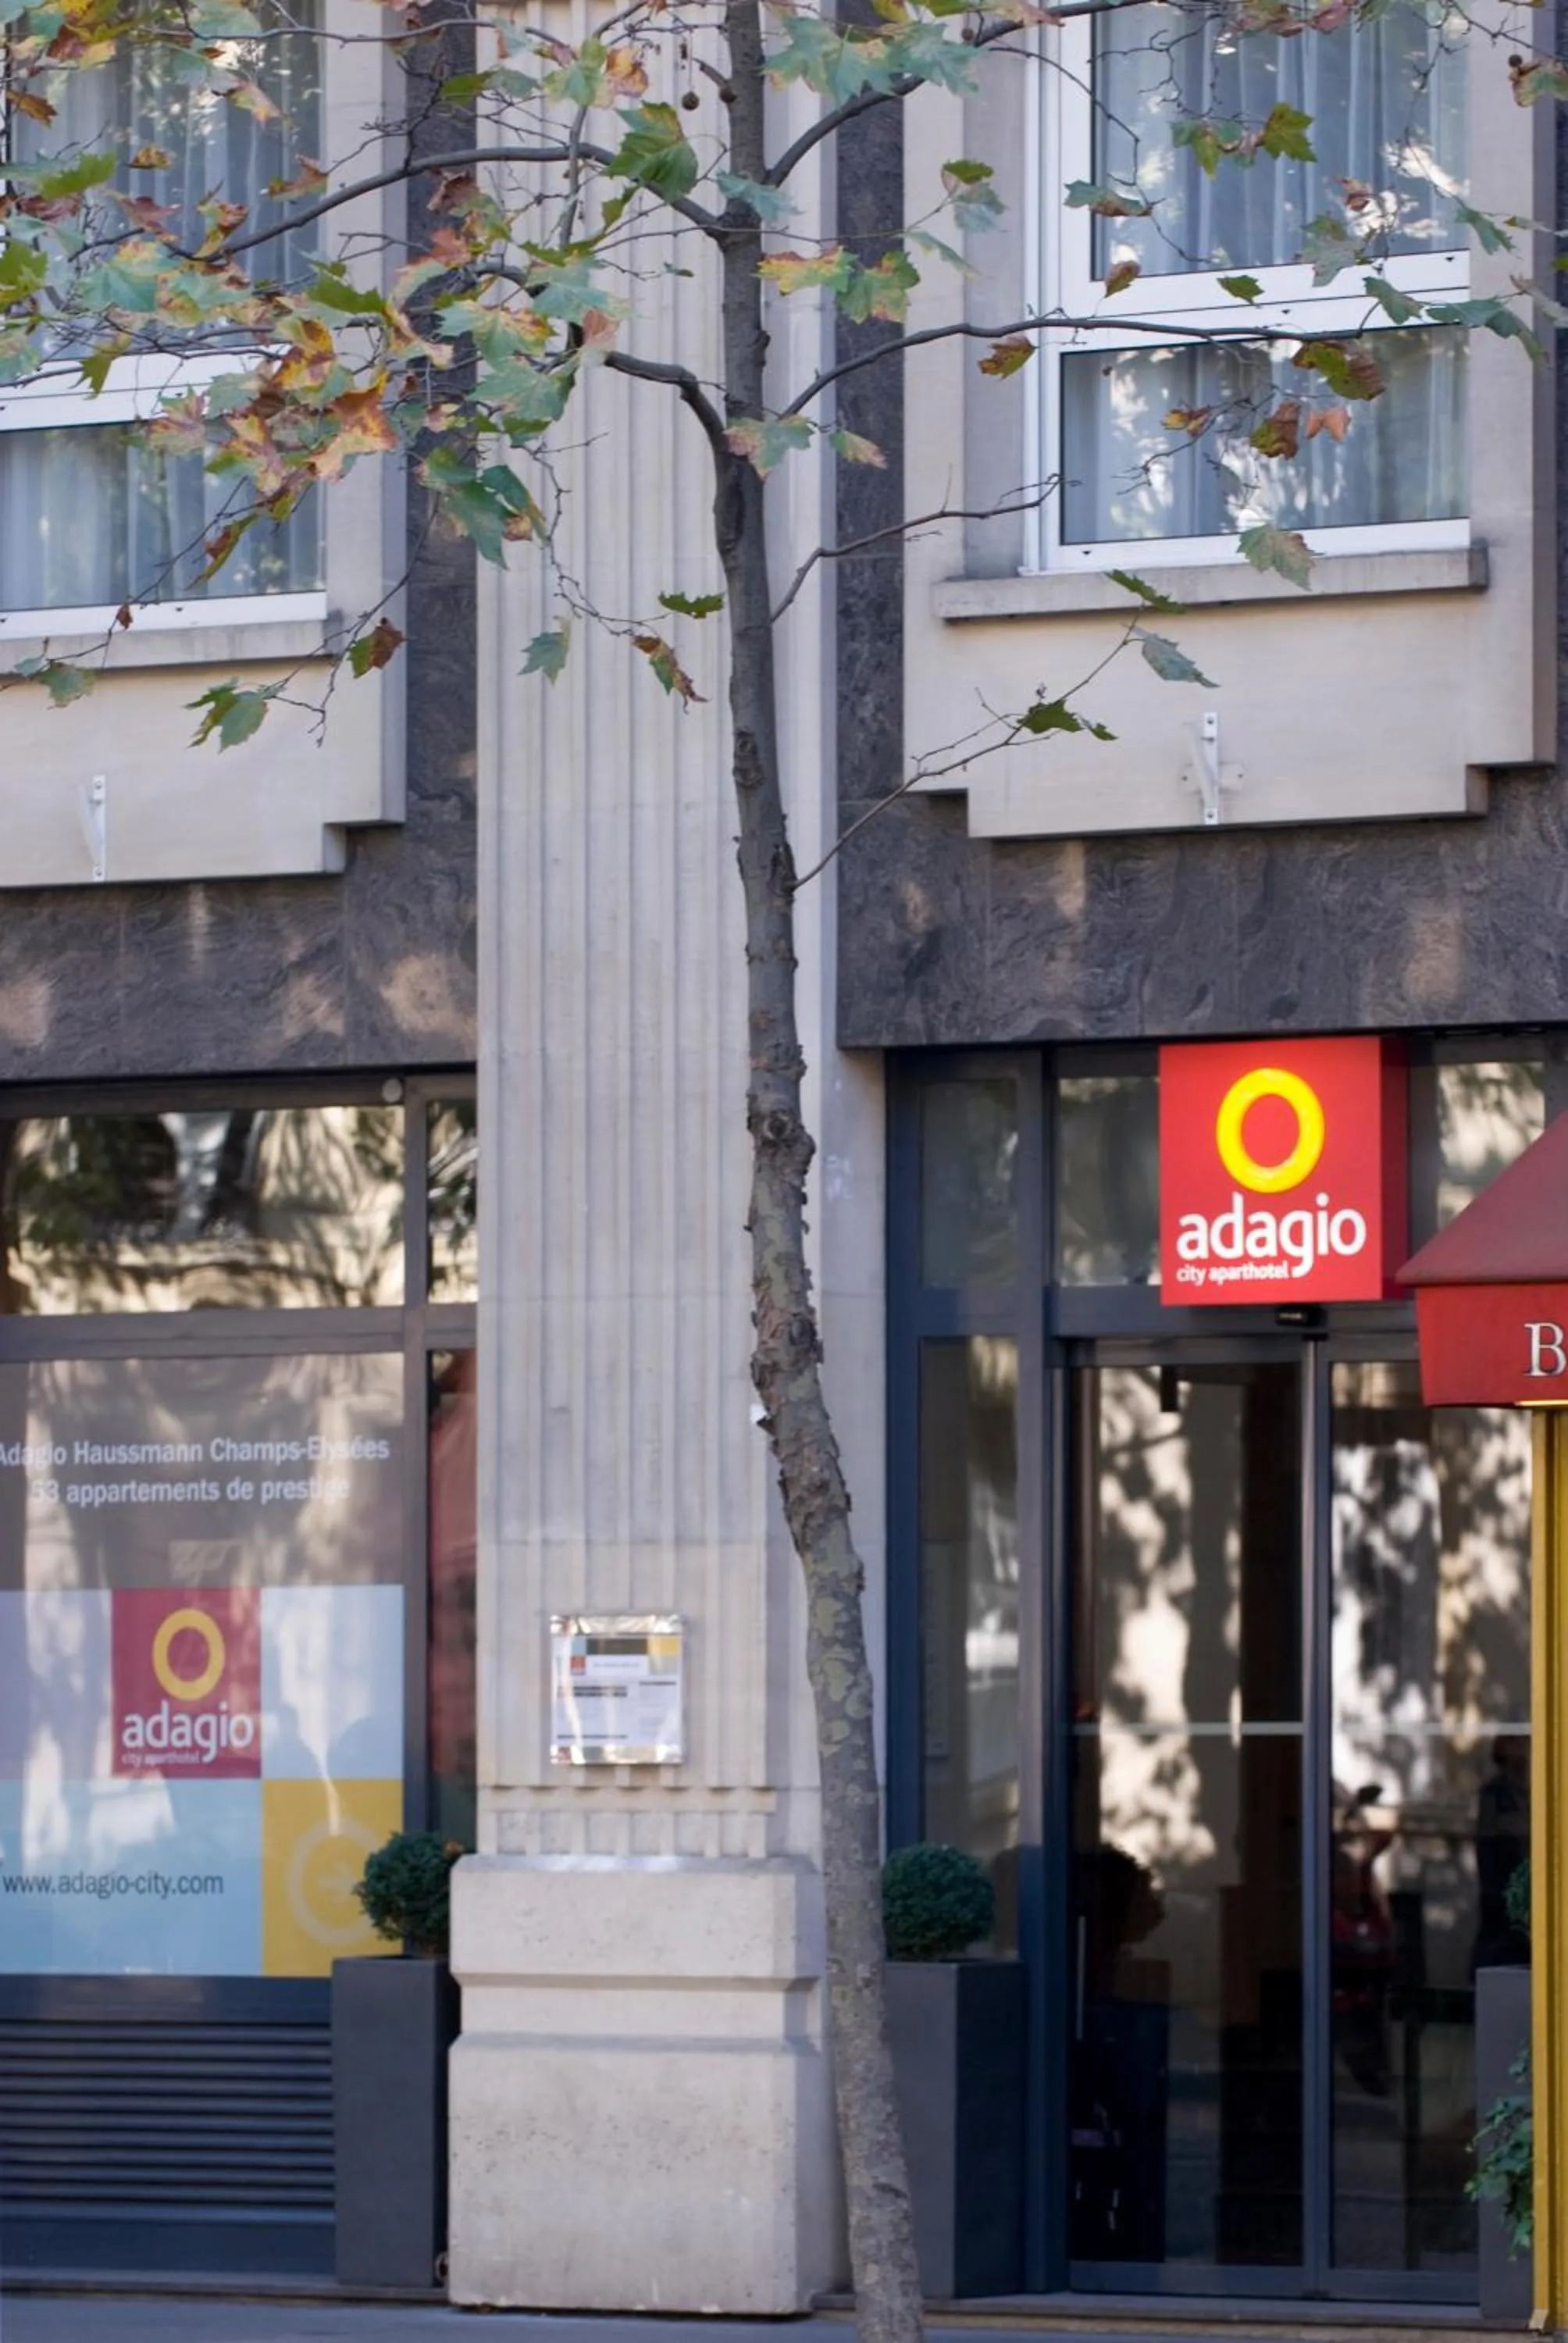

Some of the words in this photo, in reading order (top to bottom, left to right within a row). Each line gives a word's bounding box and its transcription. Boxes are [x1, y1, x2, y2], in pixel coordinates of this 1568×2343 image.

[1176, 1192, 1367, 1278] adagio
[1176, 1264, 1206, 1286] city
[1208, 1260, 1289, 1286] aparthotel
[73, 1439, 203, 1465] Haussmann
[66, 1478, 220, 1508] appartements
[226, 1475, 254, 1501] de
[260, 1475, 350, 1506] prestige
[122, 1699, 254, 1763] adagio
[2, 1870, 225, 1900] www.adagio-city.com
